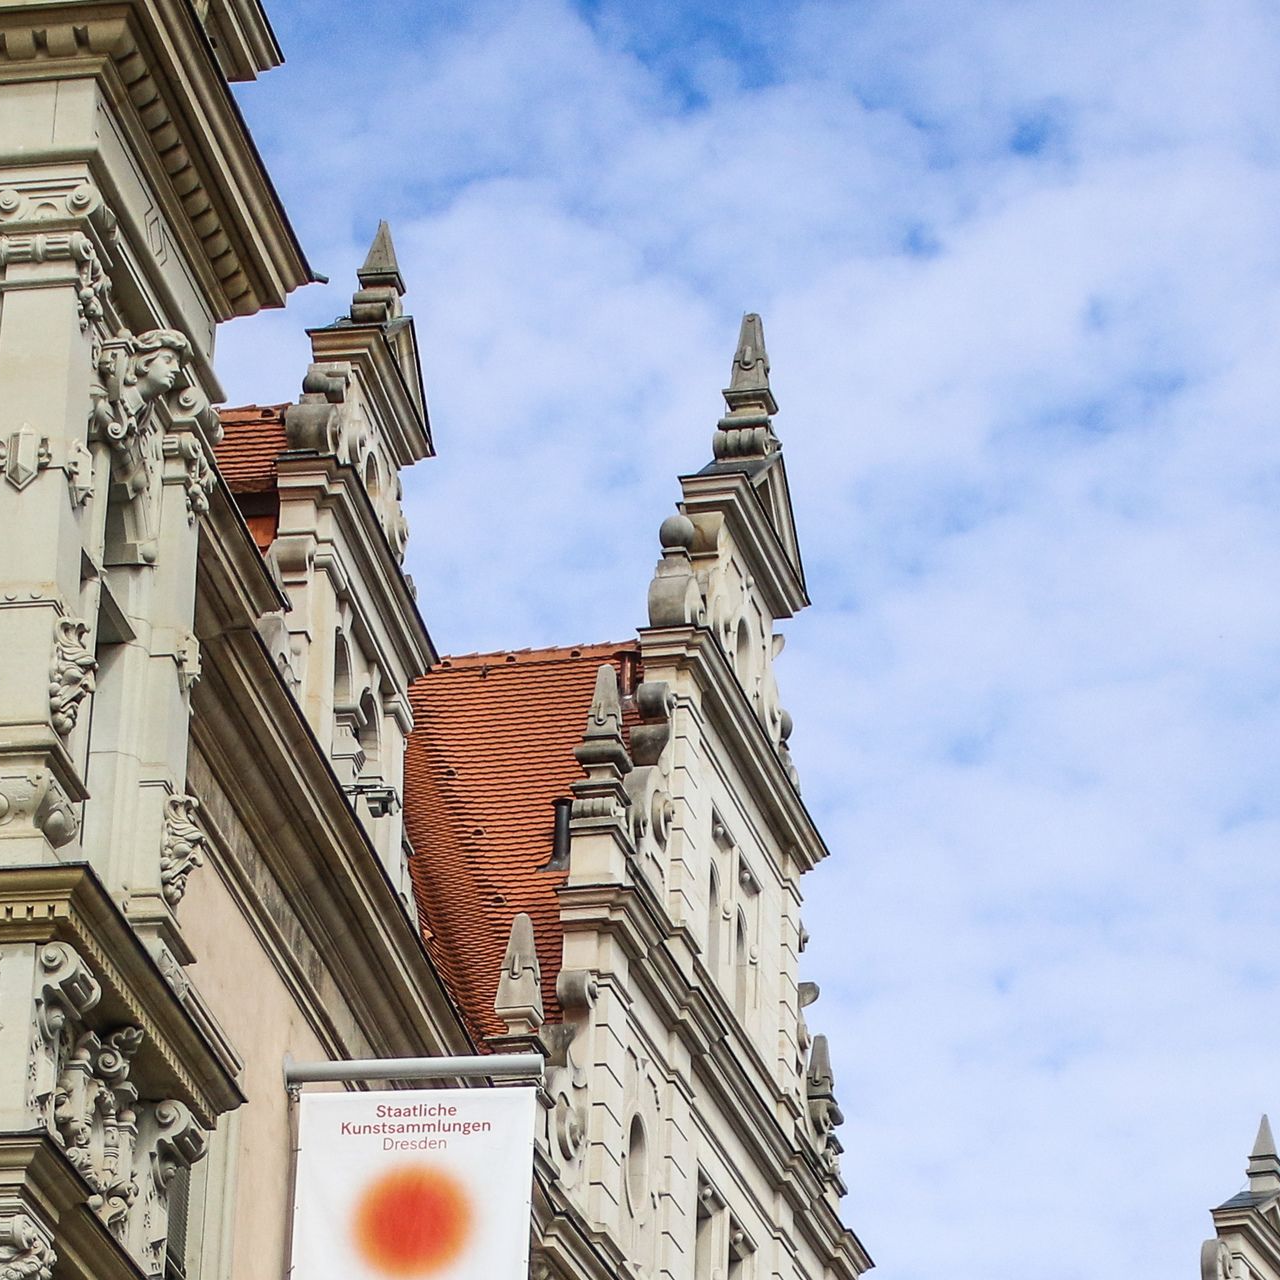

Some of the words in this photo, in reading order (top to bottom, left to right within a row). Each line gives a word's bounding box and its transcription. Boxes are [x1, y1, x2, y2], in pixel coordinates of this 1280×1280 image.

[376, 1103, 457, 1118] Staatliche
[341, 1119, 491, 1136] Kunstsammlungen
[383, 1137, 447, 1151] Dresden
